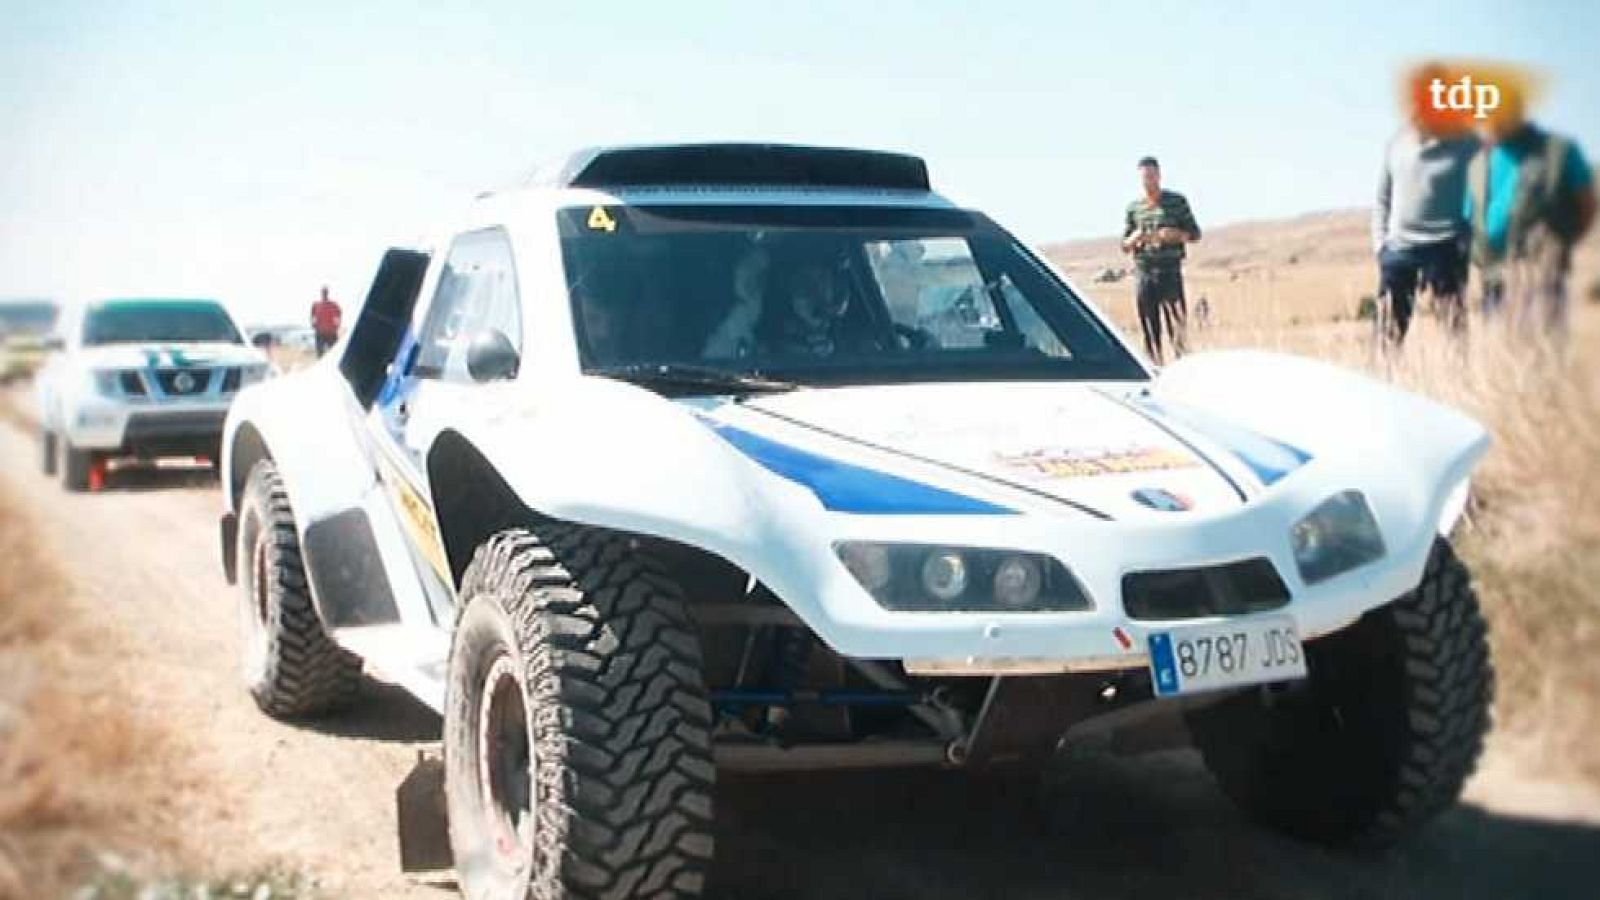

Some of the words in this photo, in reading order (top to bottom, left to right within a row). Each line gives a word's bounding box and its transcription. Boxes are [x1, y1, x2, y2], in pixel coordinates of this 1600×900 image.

[587, 205, 617, 233] 4
[1177, 633, 1248, 677] 8787
[1261, 627, 1299, 668] JDS
